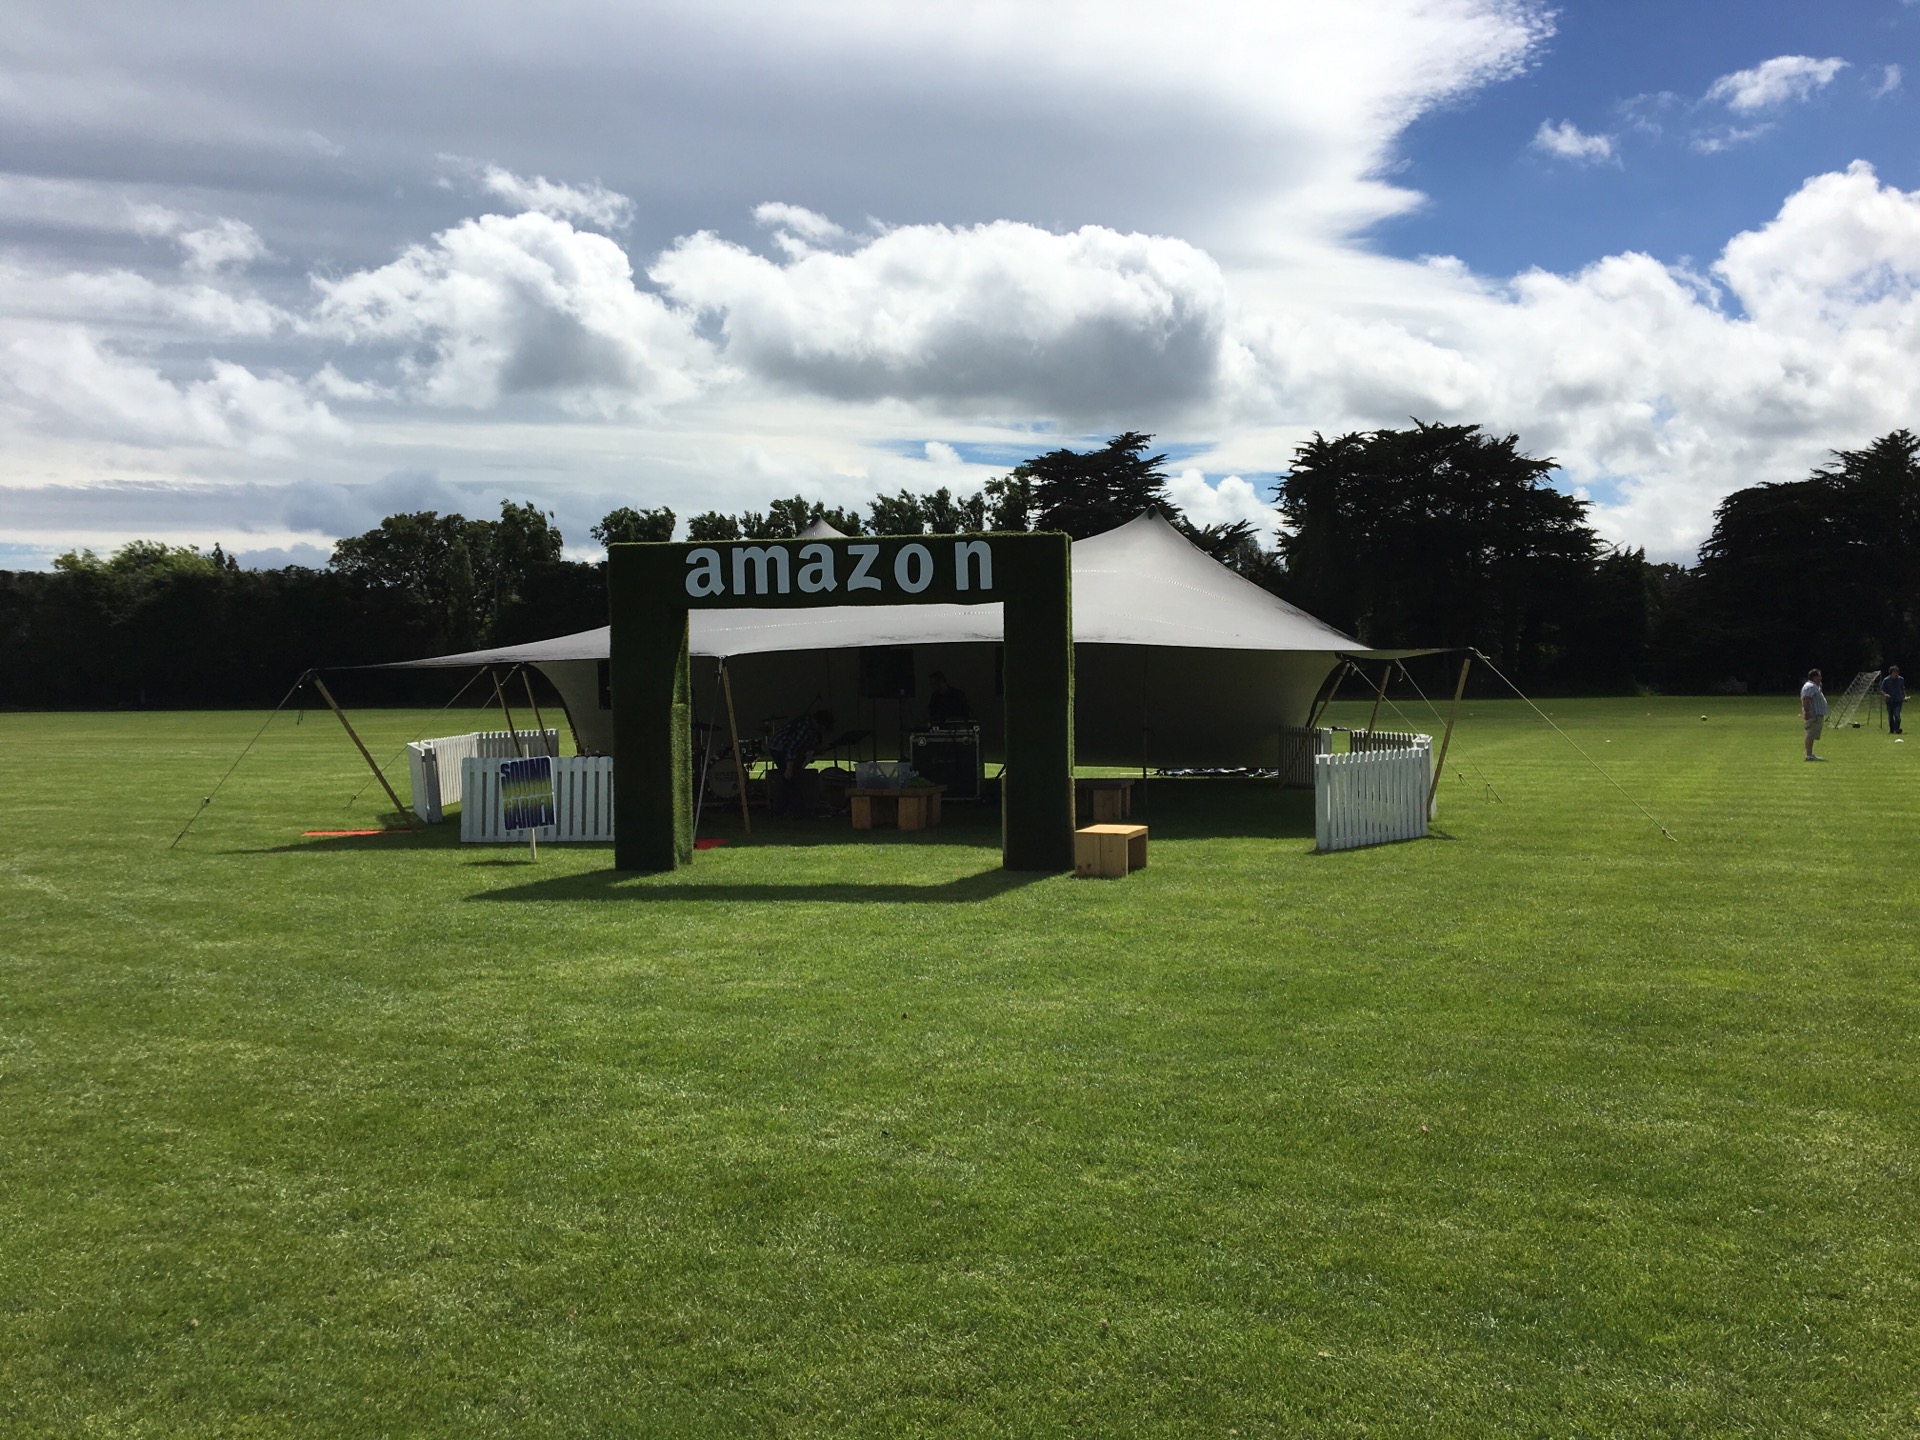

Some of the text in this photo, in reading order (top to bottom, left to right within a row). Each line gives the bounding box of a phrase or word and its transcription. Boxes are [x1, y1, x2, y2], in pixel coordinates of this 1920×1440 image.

[685, 540, 993, 597] amazon
[500, 757, 552, 799] SOUND
[502, 794, 556, 830] GARDEN
